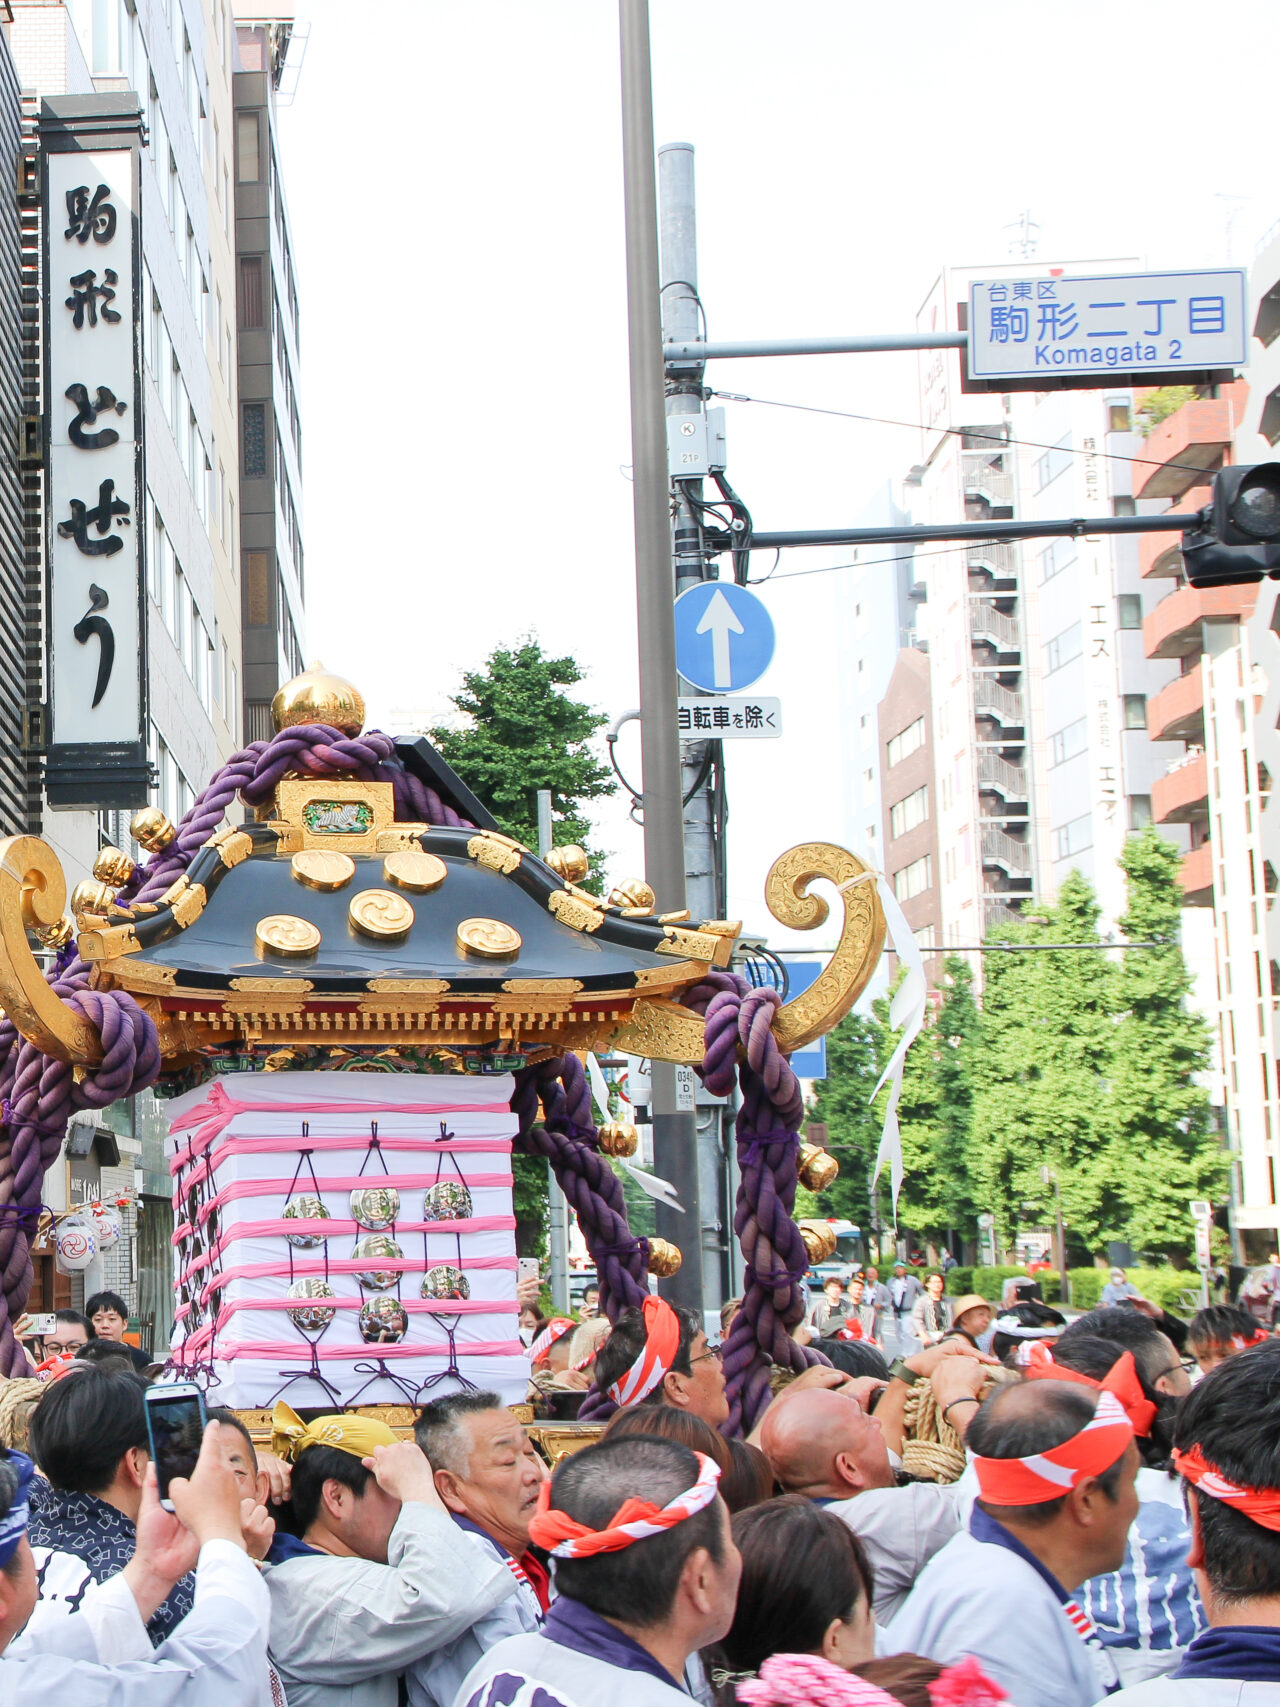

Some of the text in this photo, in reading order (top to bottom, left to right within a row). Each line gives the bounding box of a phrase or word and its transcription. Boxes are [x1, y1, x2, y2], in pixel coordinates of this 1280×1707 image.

[987, 280, 1057, 302] 台東区
[988, 296, 1225, 344] 駒形二丁目
[1034, 339, 1183, 366] Komagata 2
[58, 184, 131, 710] 駒形どぜう
[678, 706, 776, 729] 自転車を除く
[683, 1084, 690, 1093] D
